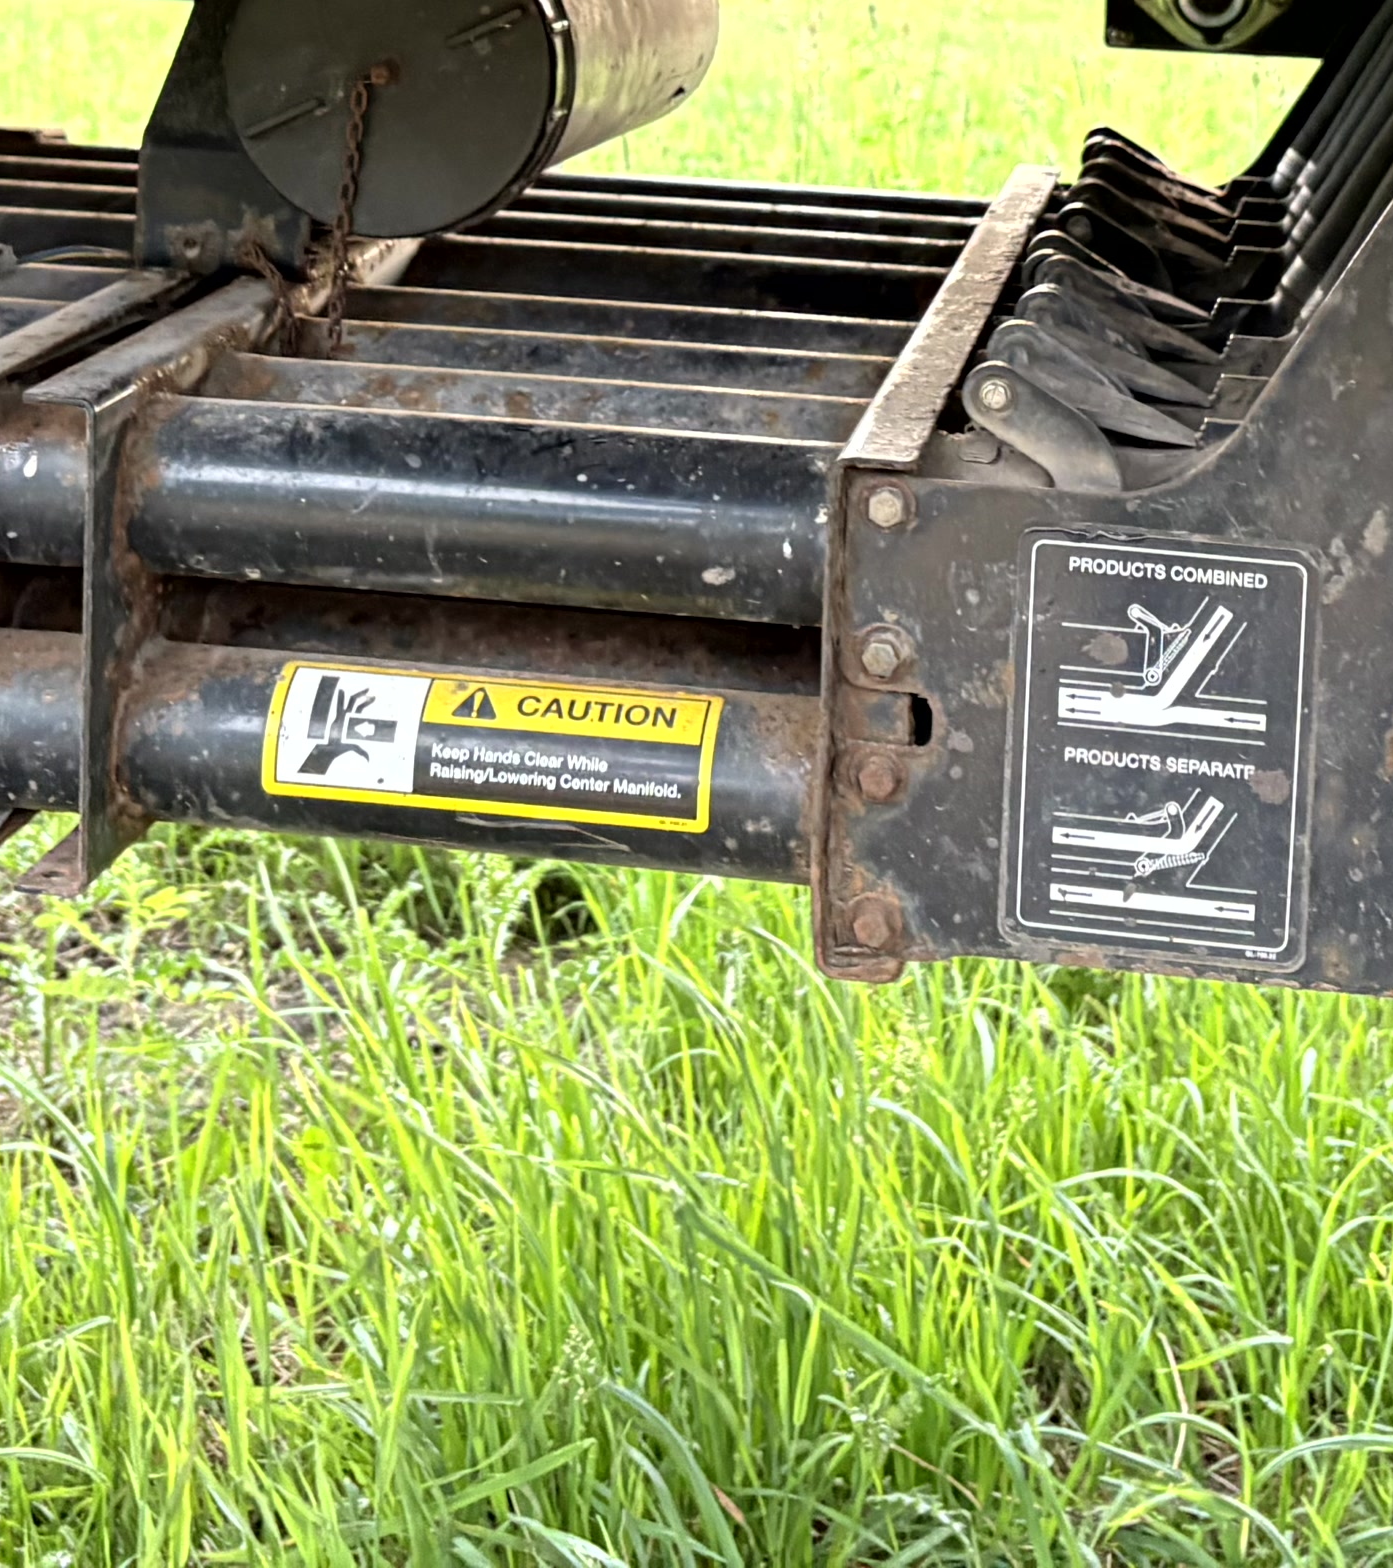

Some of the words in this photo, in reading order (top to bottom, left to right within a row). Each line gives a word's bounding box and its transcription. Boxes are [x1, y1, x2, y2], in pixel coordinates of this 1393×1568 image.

[1068, 555, 1166, 580] PRODUCTS
[1170, 565, 1267, 589] COMBINED
[516, 695, 677, 729] CAUTION
[431, 743, 470, 763] Keep
[473, 745, 520, 766] Hands
[524, 749, 563, 769] Clear
[567, 751, 608, 773] While
[1064, 746, 1161, 772] PRODUCTS
[429, 762, 557, 791] Raising/Lowering
[559, 772, 609, 793] Center
[612, 776, 682, 800] Manifold.
